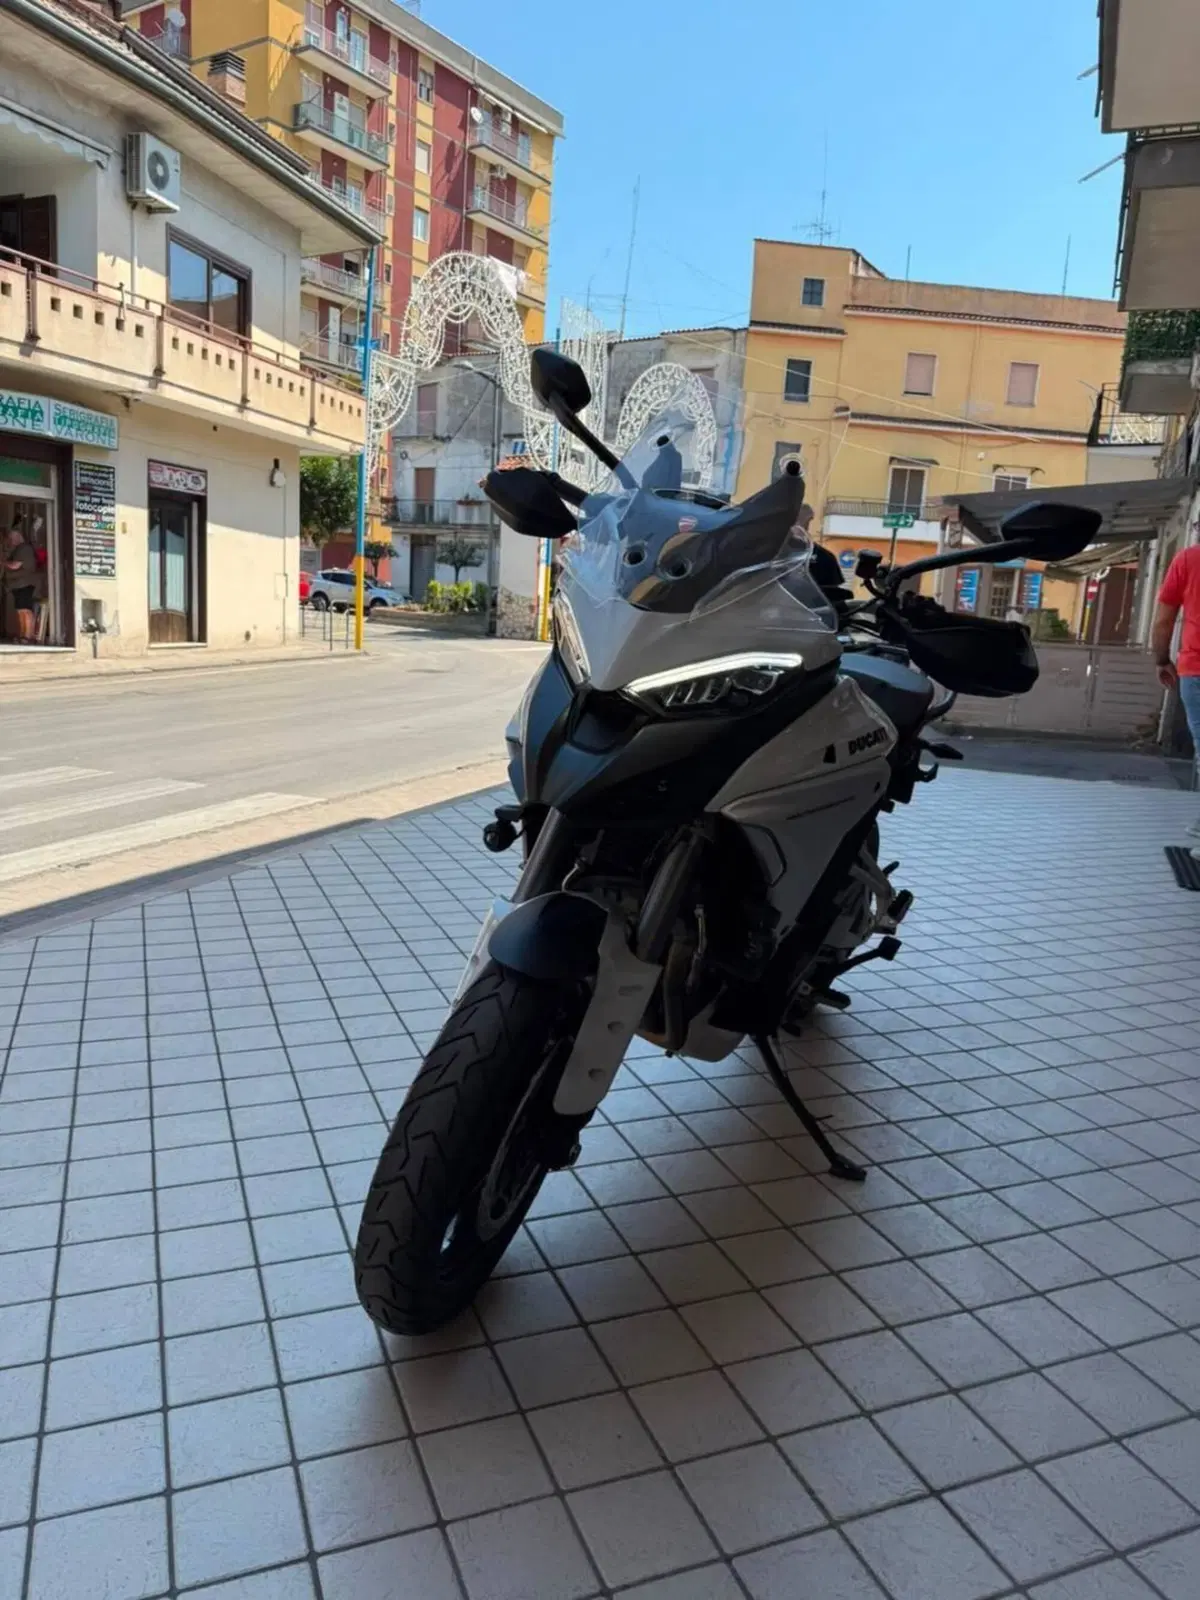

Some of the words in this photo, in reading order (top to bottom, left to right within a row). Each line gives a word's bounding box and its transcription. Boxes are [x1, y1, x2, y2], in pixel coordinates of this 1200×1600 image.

[54, 402, 117, 428] SERIGRAFIA
[55, 424, 116, 448] VARONE
[848, 727, 888, 756] DUCATI
